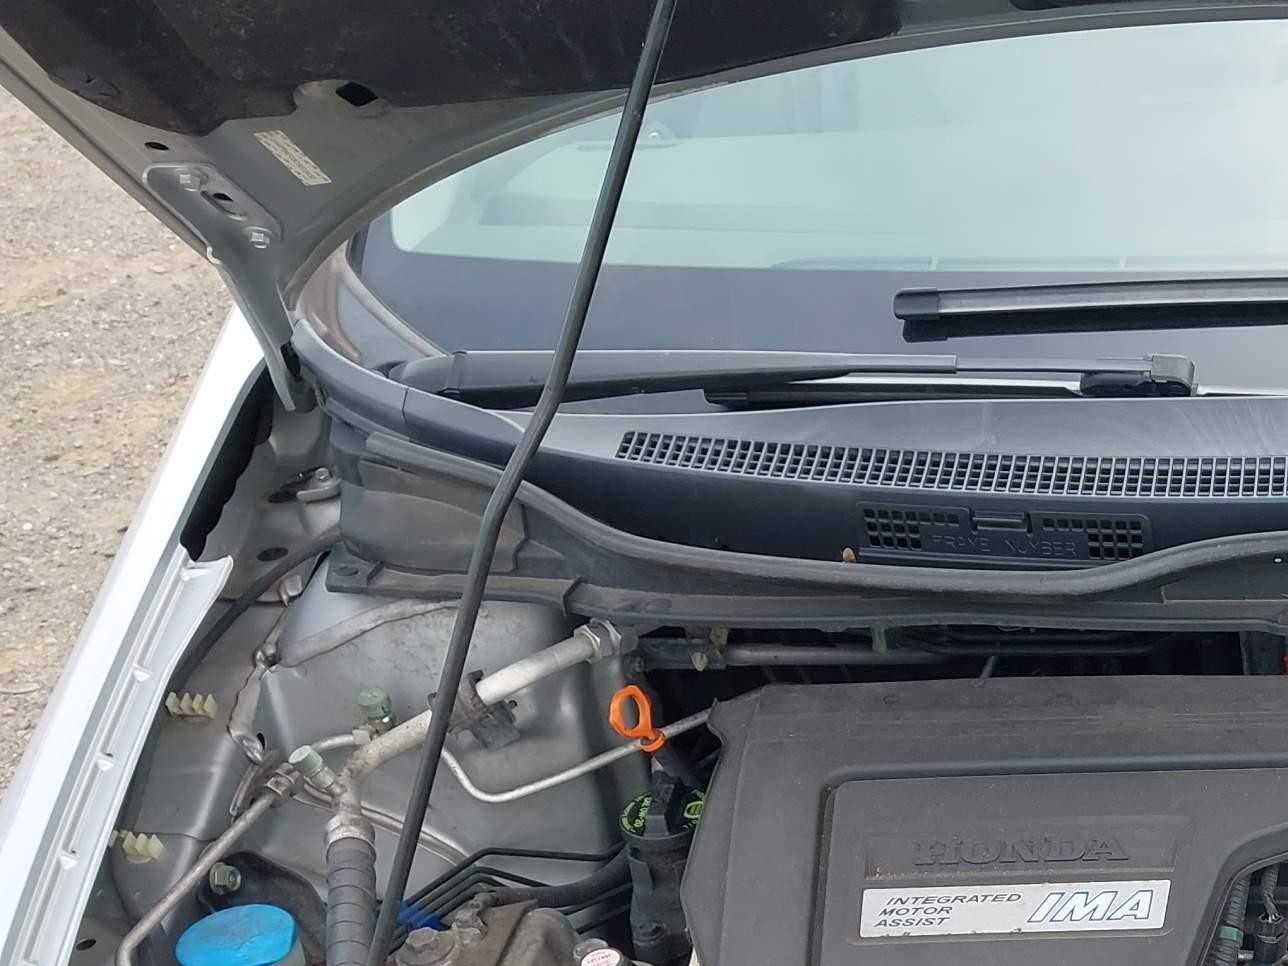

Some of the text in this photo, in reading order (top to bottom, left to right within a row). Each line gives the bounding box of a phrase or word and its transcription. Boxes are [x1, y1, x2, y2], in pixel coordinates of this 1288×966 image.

[931, 535, 1077, 555] FRAME NUMBER
[914, 840, 1129, 866] HONDA
[886, 893, 1022, 906] INTEGRATED
[1027, 889, 1155, 923] IMA
[879, 907, 953, 917] MOTOR
[874, 917, 950, 928] ASSIST
